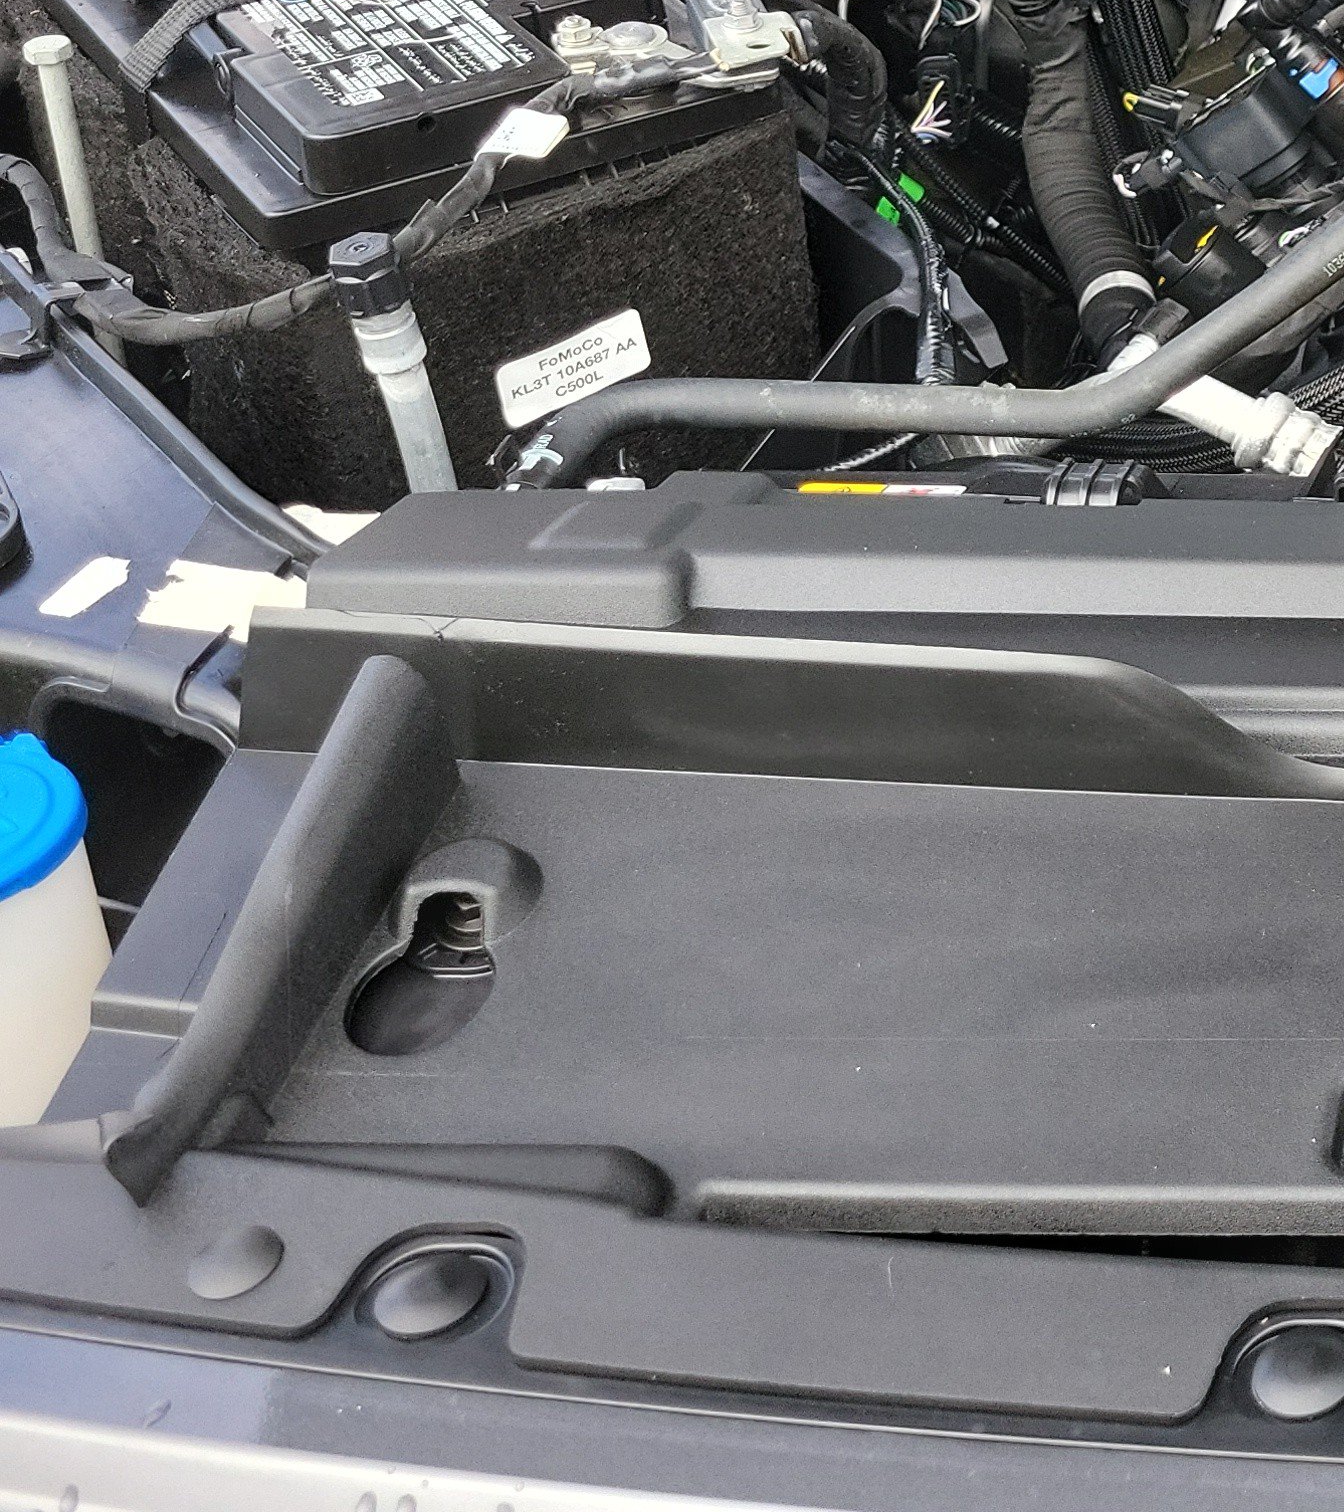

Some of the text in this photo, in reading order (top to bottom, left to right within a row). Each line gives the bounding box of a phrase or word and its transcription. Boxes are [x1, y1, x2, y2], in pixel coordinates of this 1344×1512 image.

[511, 337, 638, 400] KL3T 10A687 AA
[538, 336, 604, 372] FoMoCo
[554, 369, 604, 397] C500L
